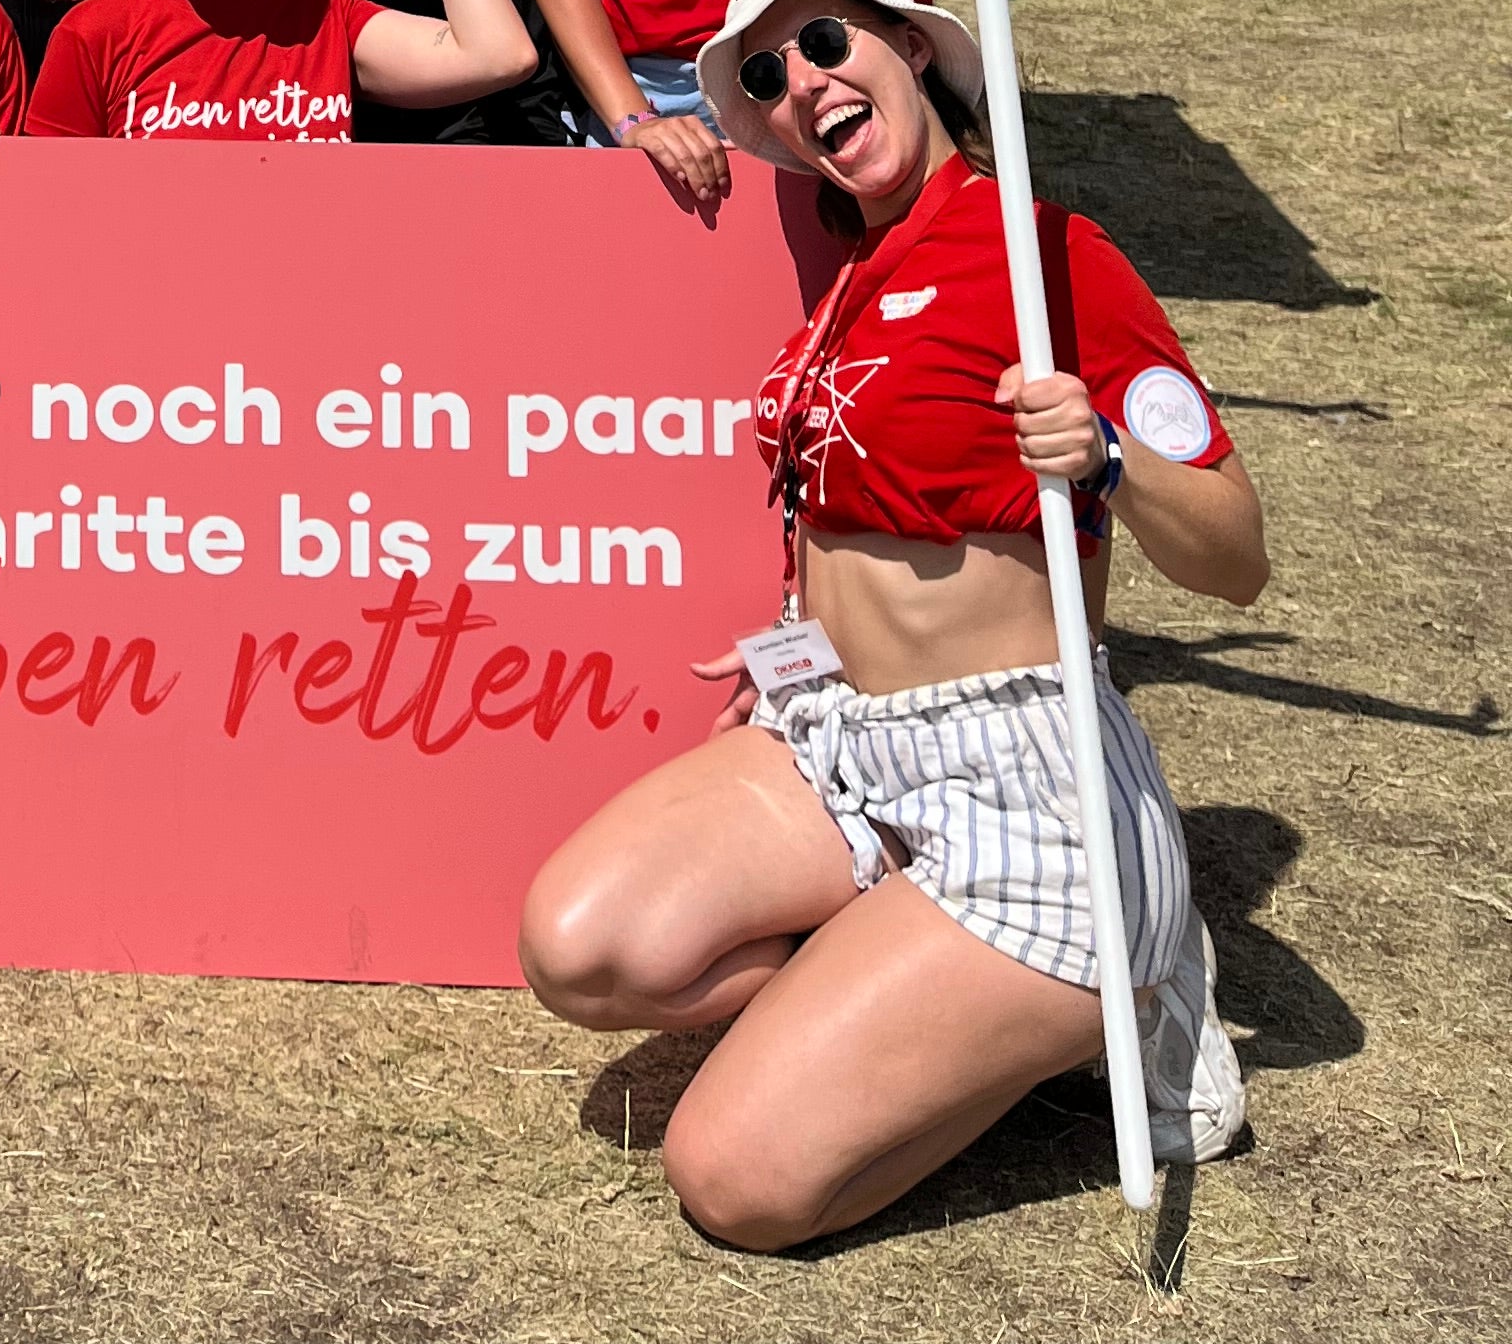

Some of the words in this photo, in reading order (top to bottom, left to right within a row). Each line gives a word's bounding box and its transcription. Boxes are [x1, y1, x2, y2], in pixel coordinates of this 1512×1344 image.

[124, 81, 232, 140] Leben
[238, 79, 353, 130] retten
[32, 363, 281, 446] noch
[316, 363, 471, 450] ein
[507, 392, 751, 478] paar
[280, 492, 431, 579] bis
[463, 523, 683, 587] zum
[223, 570, 661, 756] retten.
